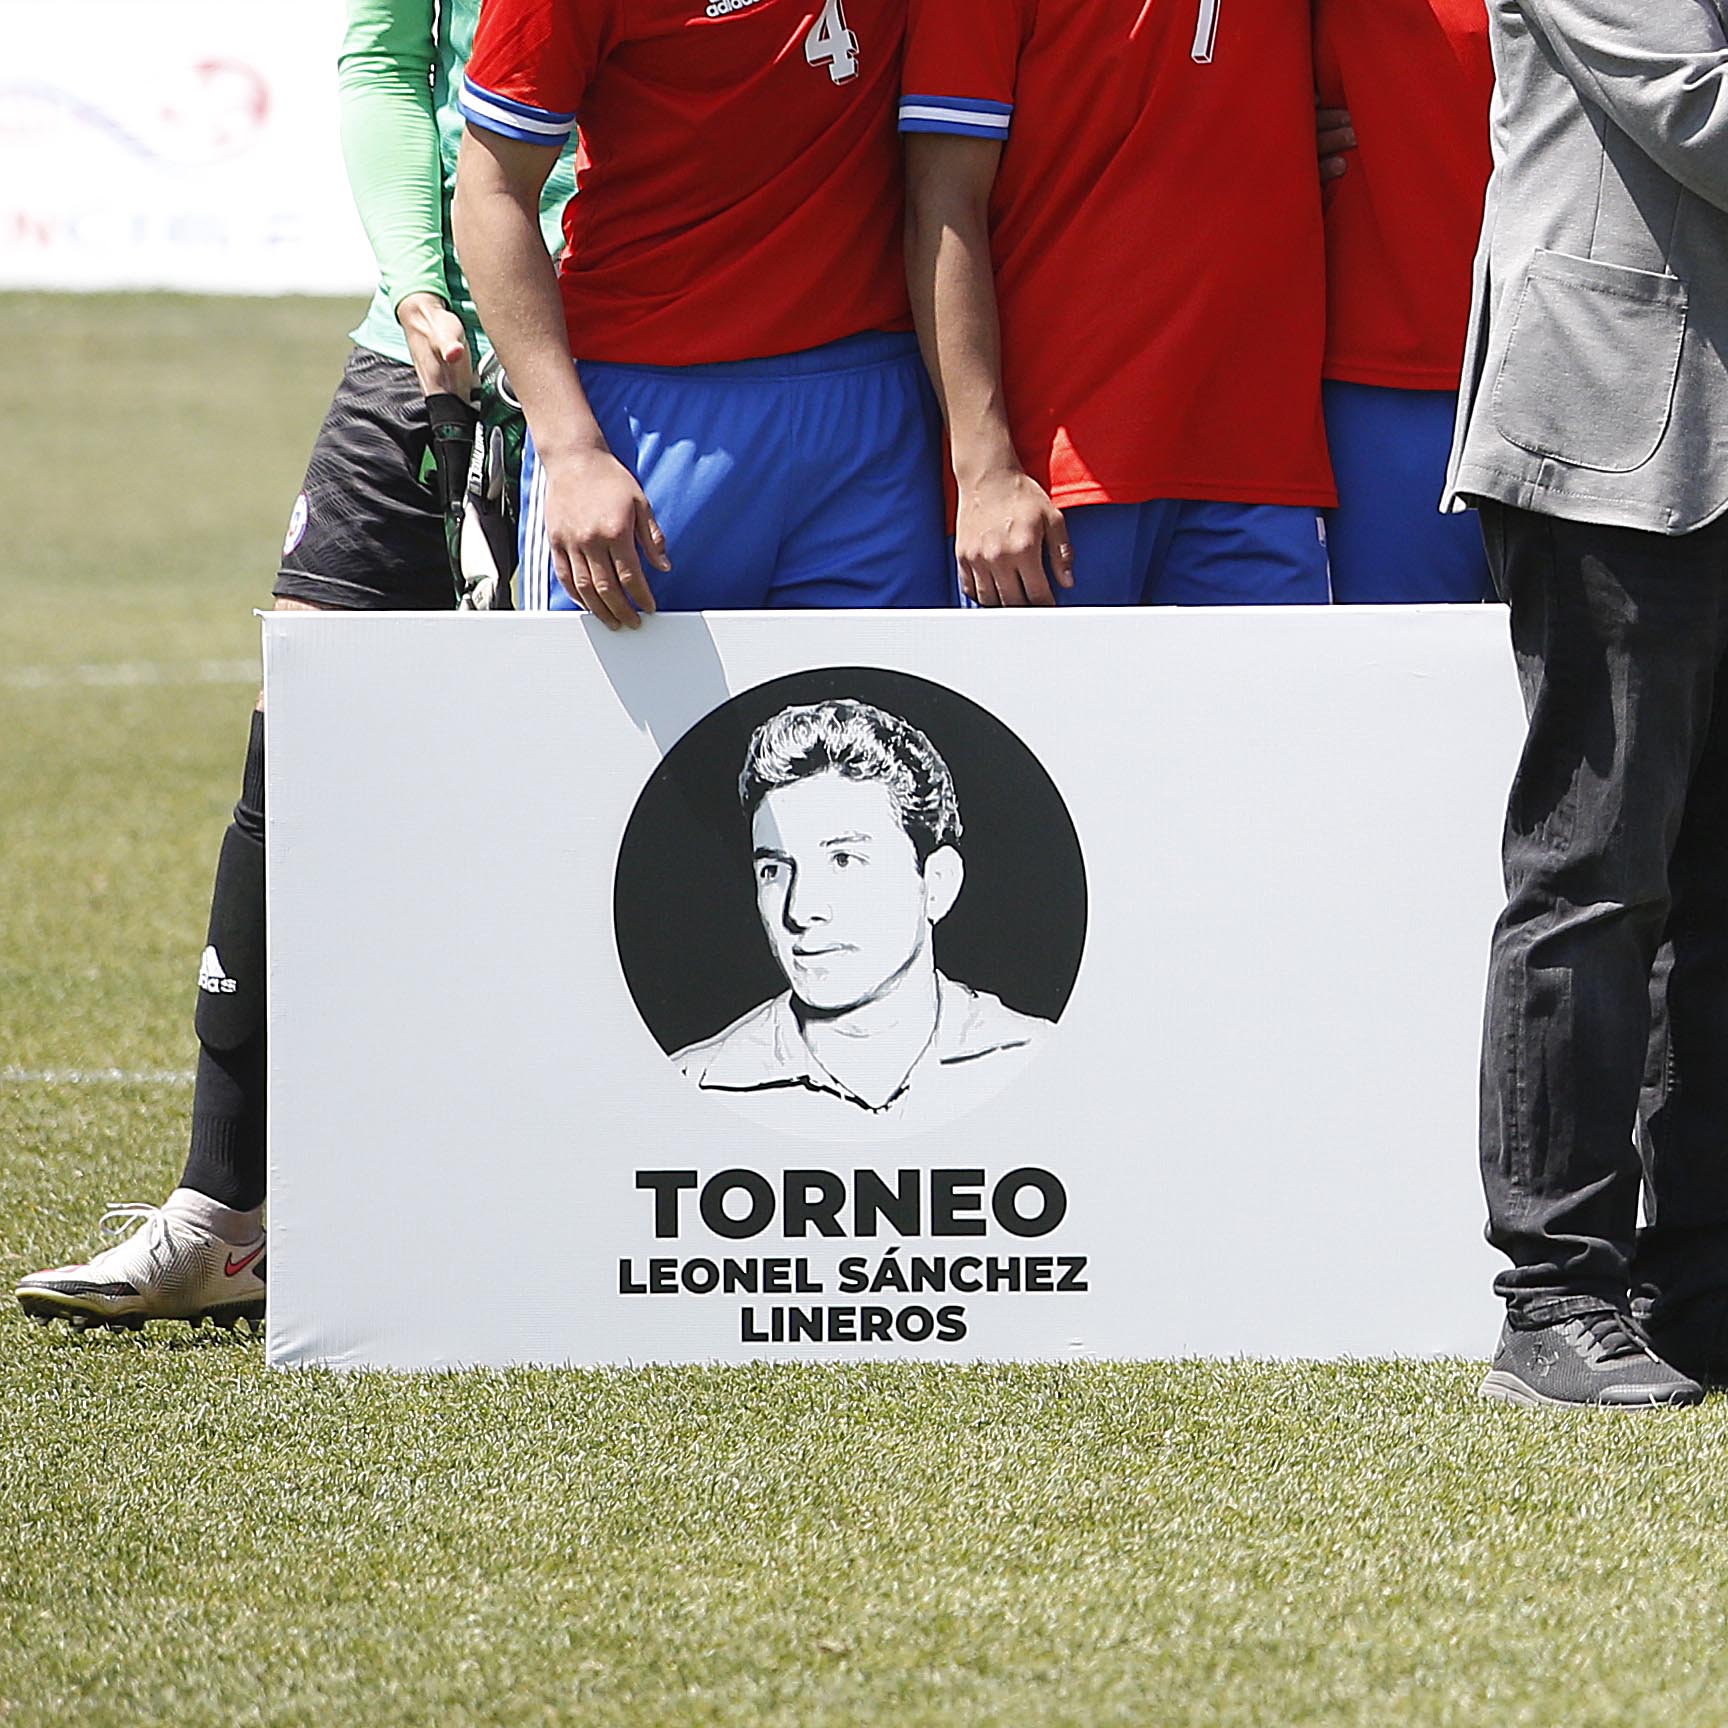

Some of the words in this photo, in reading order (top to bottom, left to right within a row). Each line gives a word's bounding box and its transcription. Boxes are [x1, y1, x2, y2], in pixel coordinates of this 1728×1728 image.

[198, 969, 237, 993] das
[635, 1167, 1068, 1239] TORNEO
[619, 1257, 823, 1295] LEONEL
[838, 1246, 1088, 1294] SÁNCHEZ
[741, 1305, 967, 1343] LINEROS
